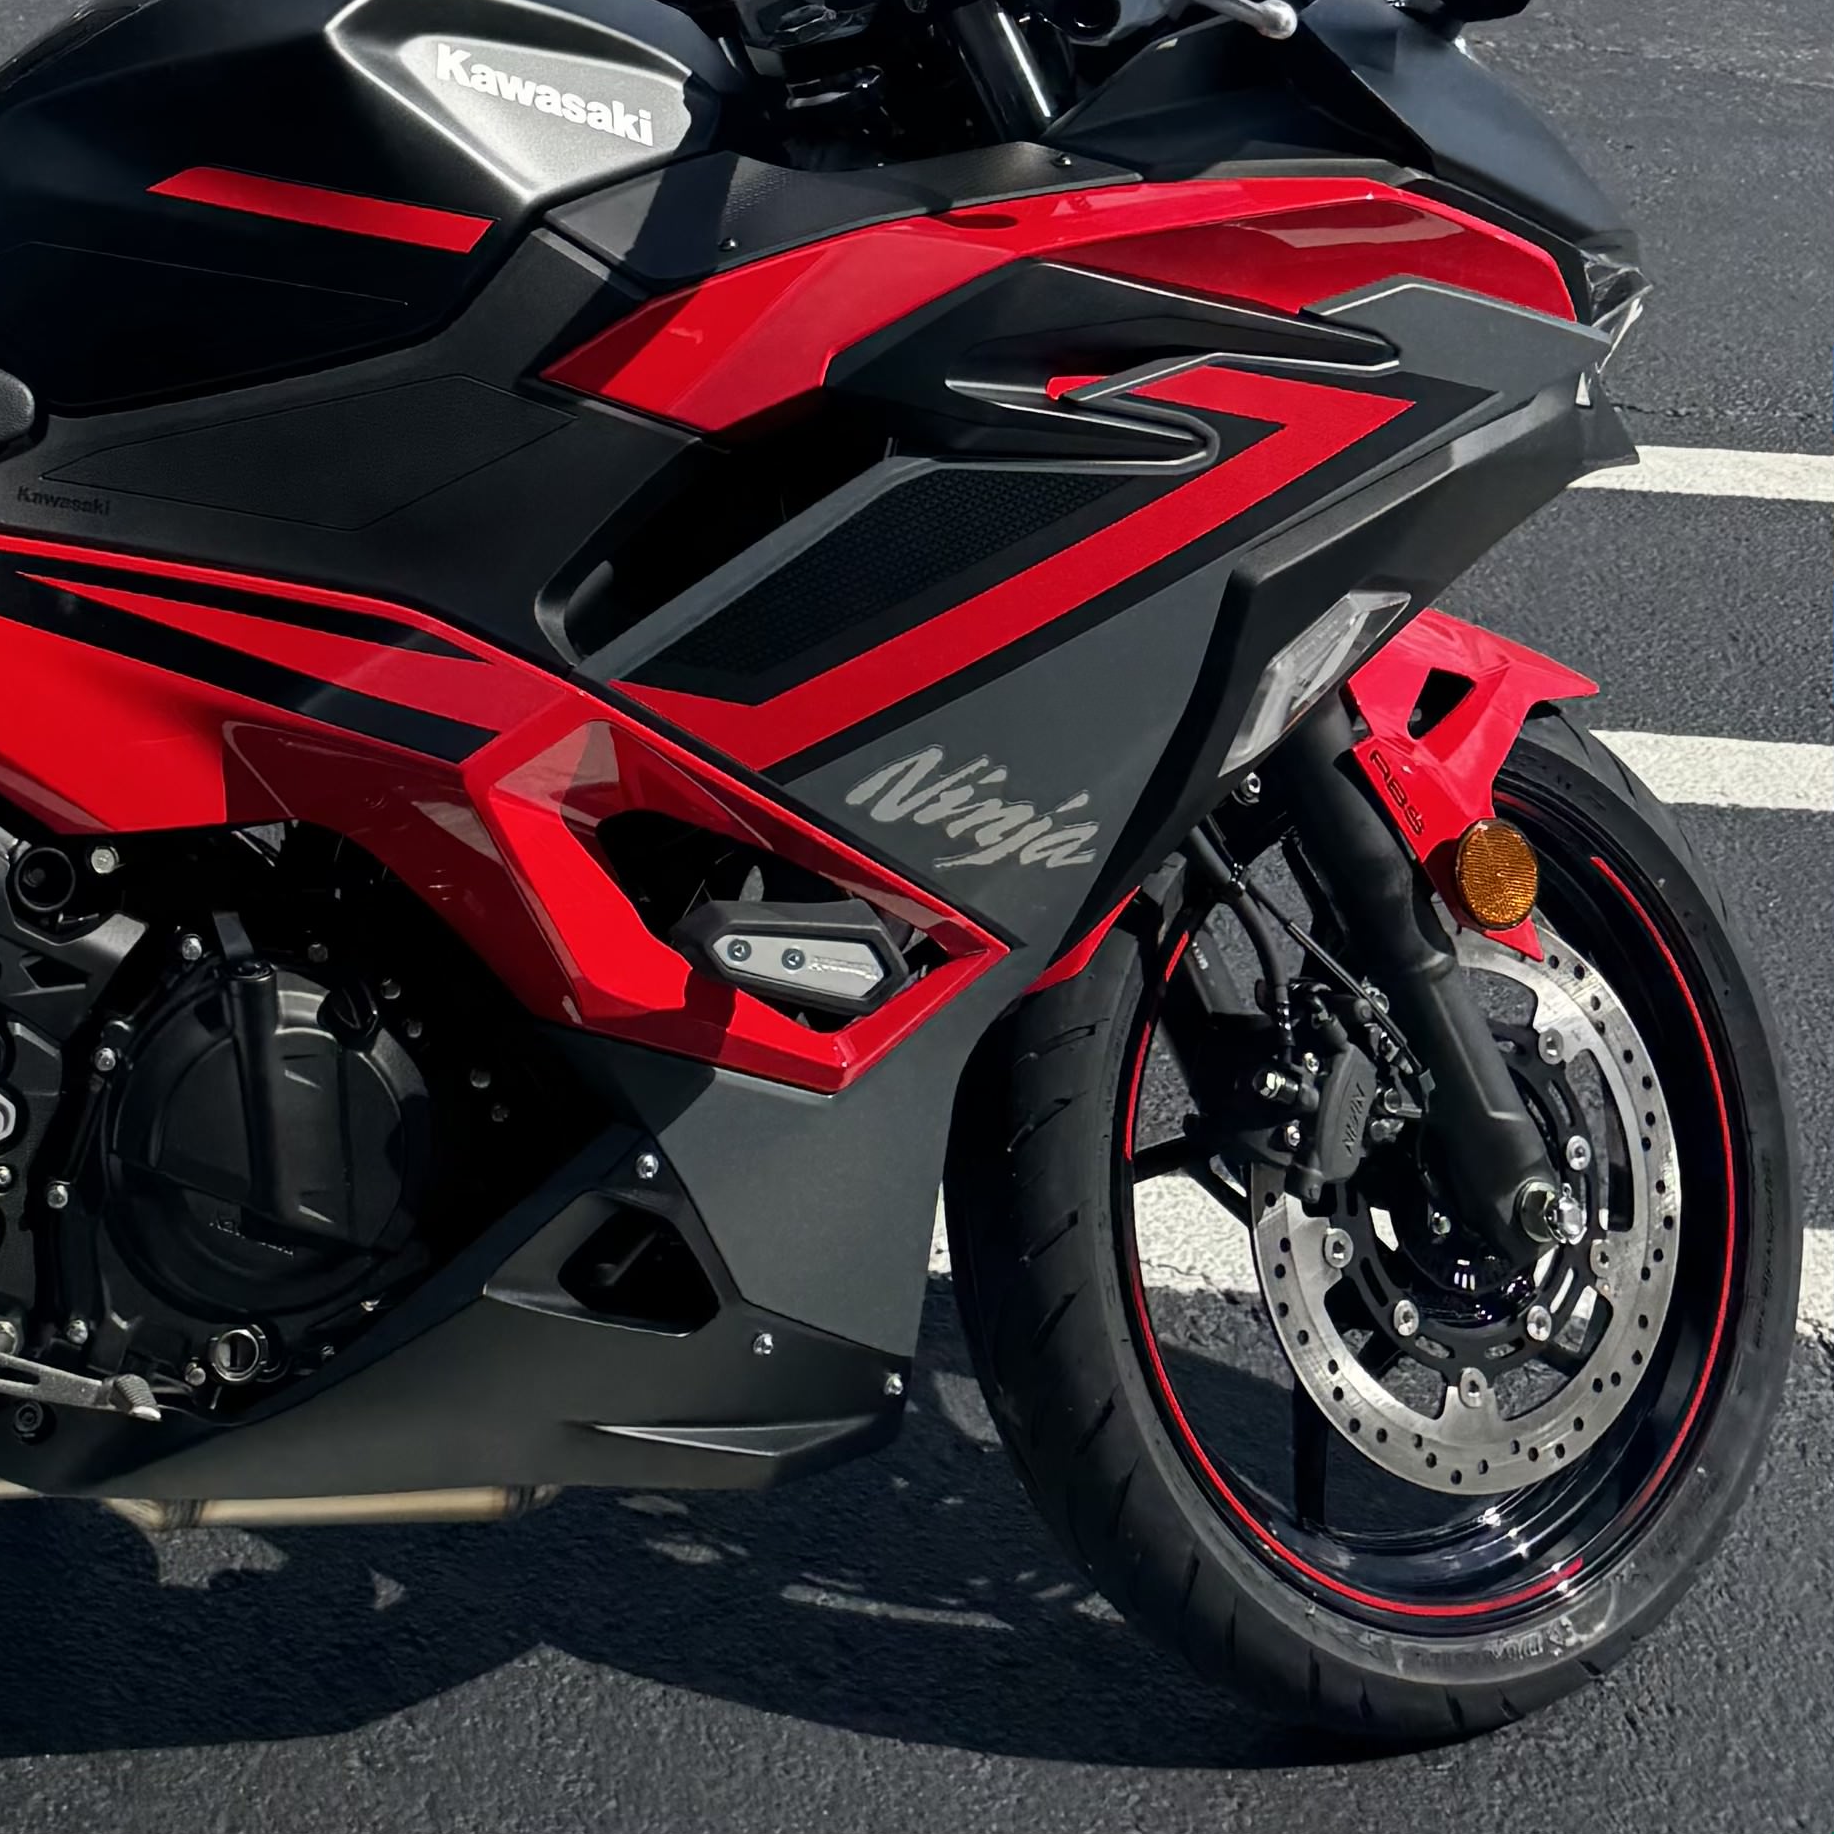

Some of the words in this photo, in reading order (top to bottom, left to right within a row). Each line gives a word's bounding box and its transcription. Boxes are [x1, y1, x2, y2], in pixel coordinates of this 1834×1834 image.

[435, 43, 655, 147] Kawasaki
[17, 485, 111, 516] Kawasaki
[845, 744, 1100, 871] Ninja
[1369, 749, 1425, 836] ABS
